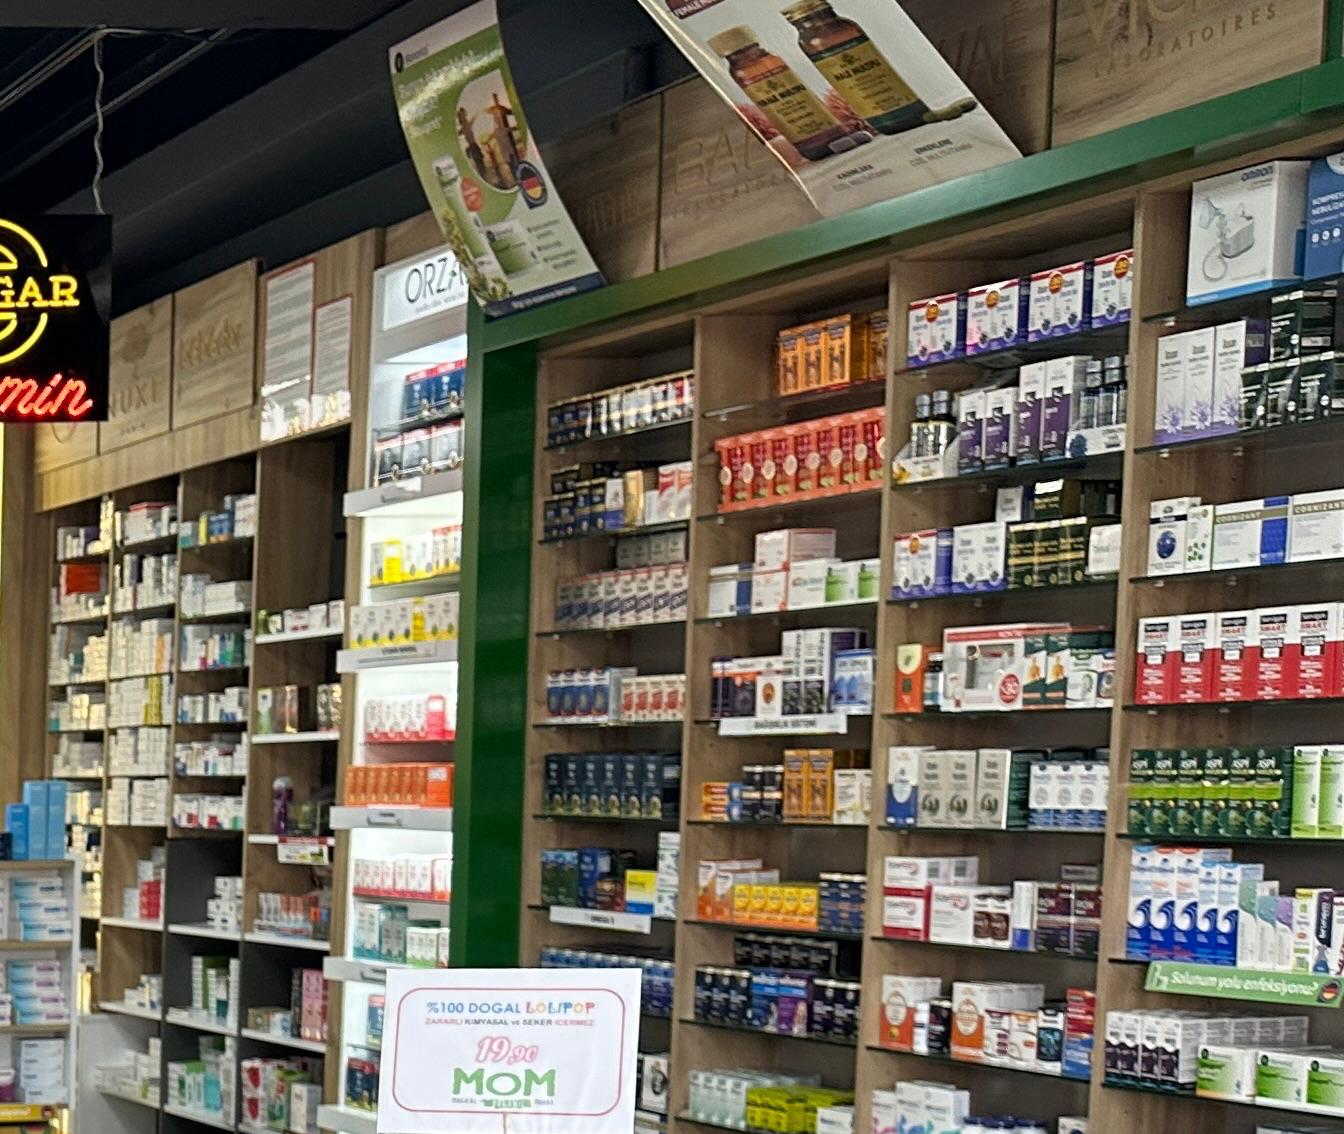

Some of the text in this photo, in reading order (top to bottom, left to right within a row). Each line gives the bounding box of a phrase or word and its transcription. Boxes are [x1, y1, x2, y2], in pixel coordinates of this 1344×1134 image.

[404, 257, 464, 304] ORZA
[426, 1002, 464, 1014] %100
[452, 1067, 556, 1097] MOM
